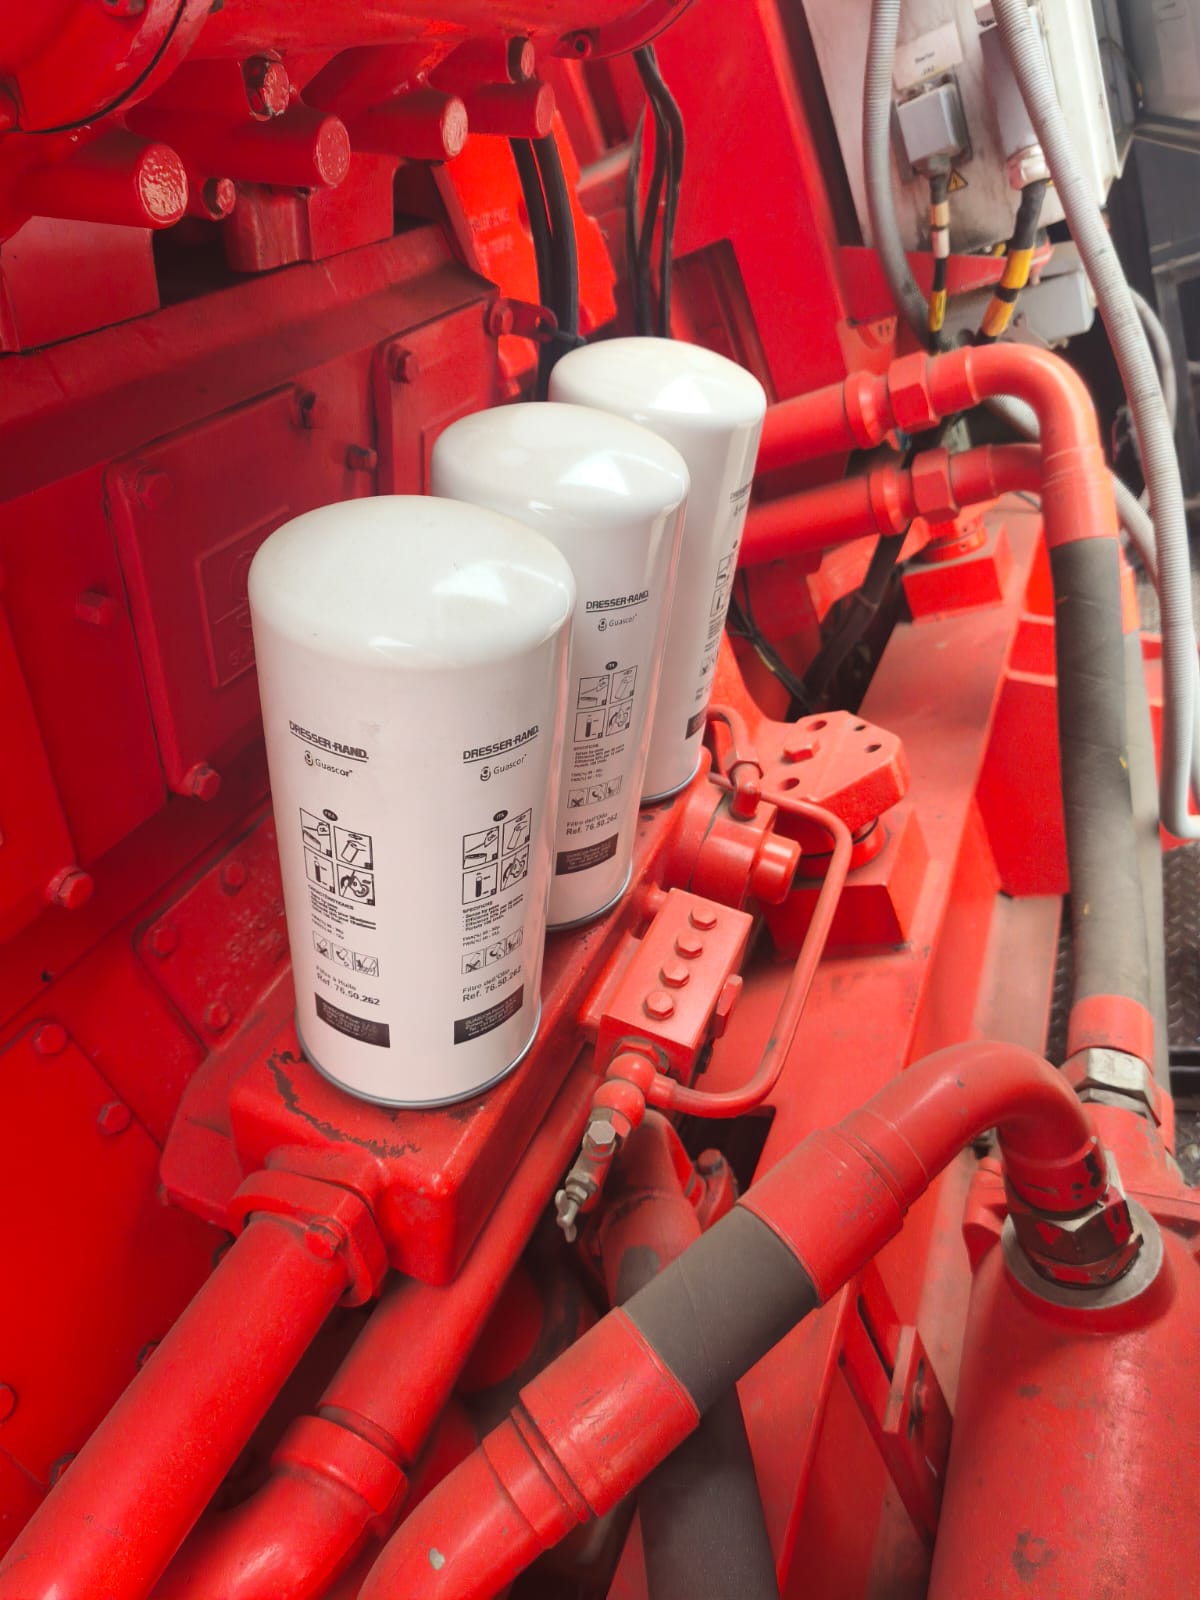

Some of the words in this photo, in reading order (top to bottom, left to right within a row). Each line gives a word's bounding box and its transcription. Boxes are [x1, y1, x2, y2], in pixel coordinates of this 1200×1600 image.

[586, 590, 649, 610] DRESSER-RAND
[463, 725, 539, 760] DRESSER-RAND
[334, 984, 381, 1006] 76.50.262
[462, 990, 482, 1002] Ref.
